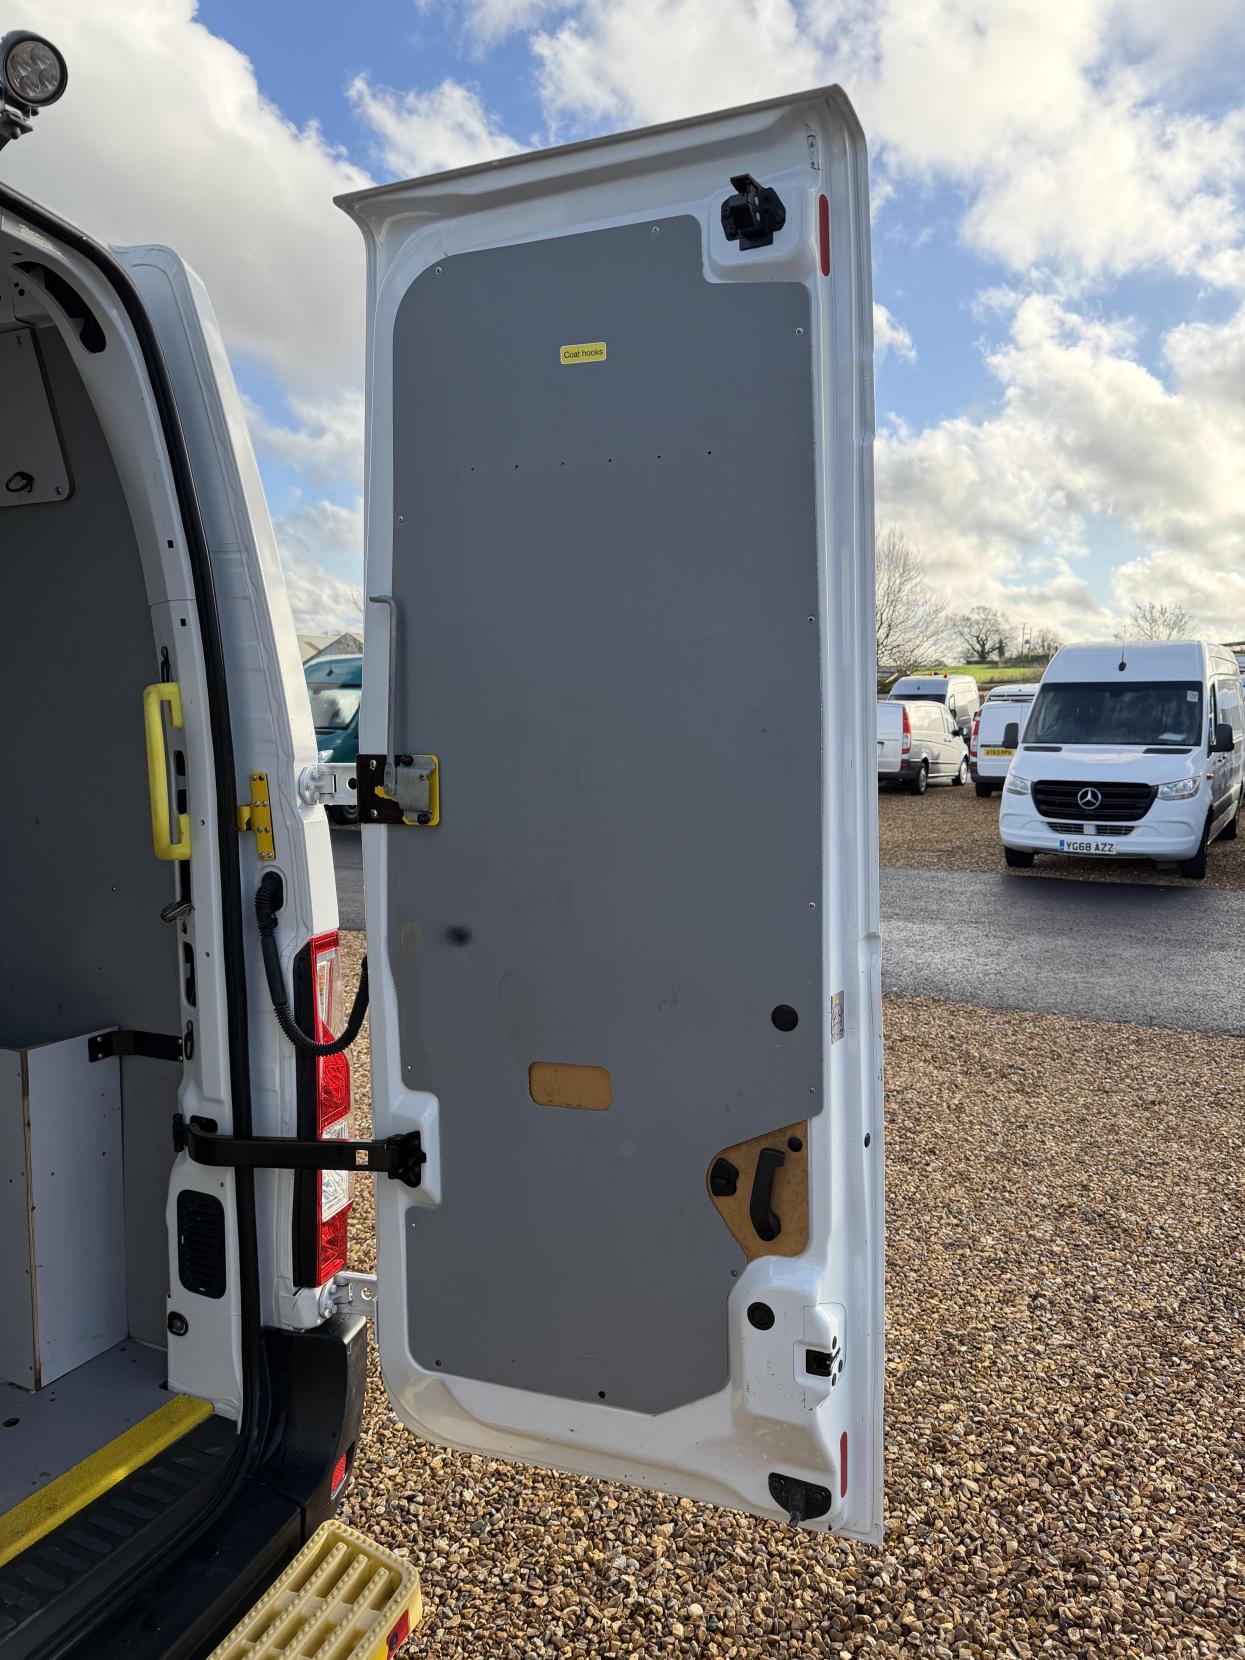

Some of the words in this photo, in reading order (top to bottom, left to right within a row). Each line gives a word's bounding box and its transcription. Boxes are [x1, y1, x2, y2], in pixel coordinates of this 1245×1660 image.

[563, 351, 580, 359] Coat
[582, 348, 604, 357] hooks
[1066, 841, 1091, 851] YG68
[1094, 843, 1114, 853] AZZ
